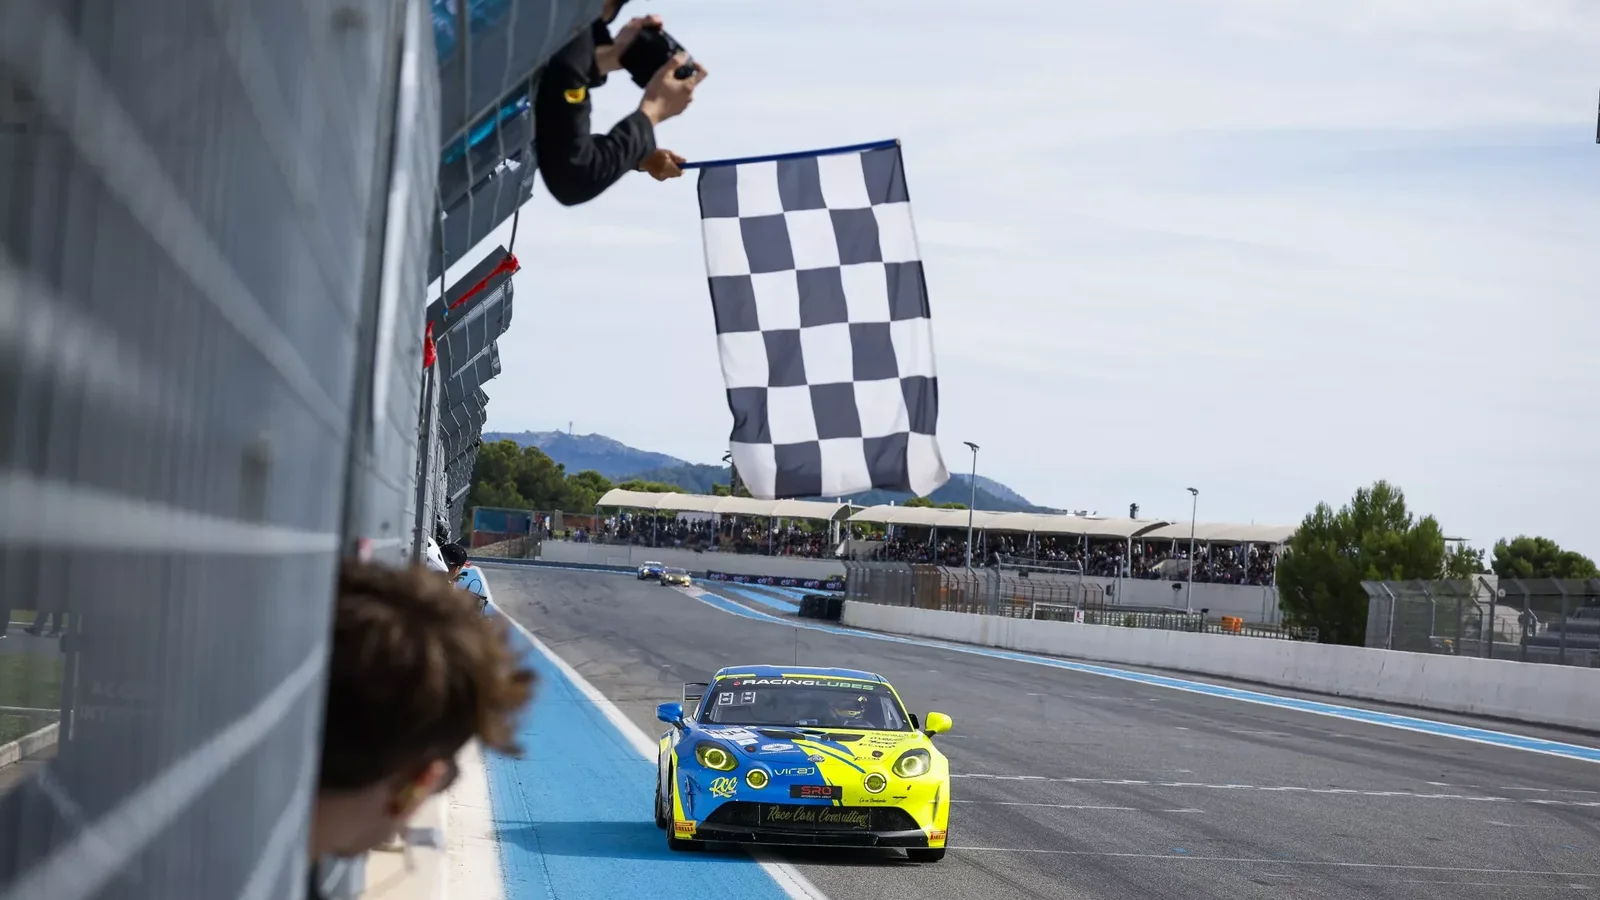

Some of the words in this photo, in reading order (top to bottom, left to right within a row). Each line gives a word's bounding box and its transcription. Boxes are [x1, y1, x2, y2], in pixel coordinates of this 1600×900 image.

[742, 679, 874, 690] RACINGLUBES
[801, 785, 832, 795] SRO
[767, 806, 792, 822] Race
[793, 806, 815, 822] Cars
[818, 806, 869, 829] Consulting
